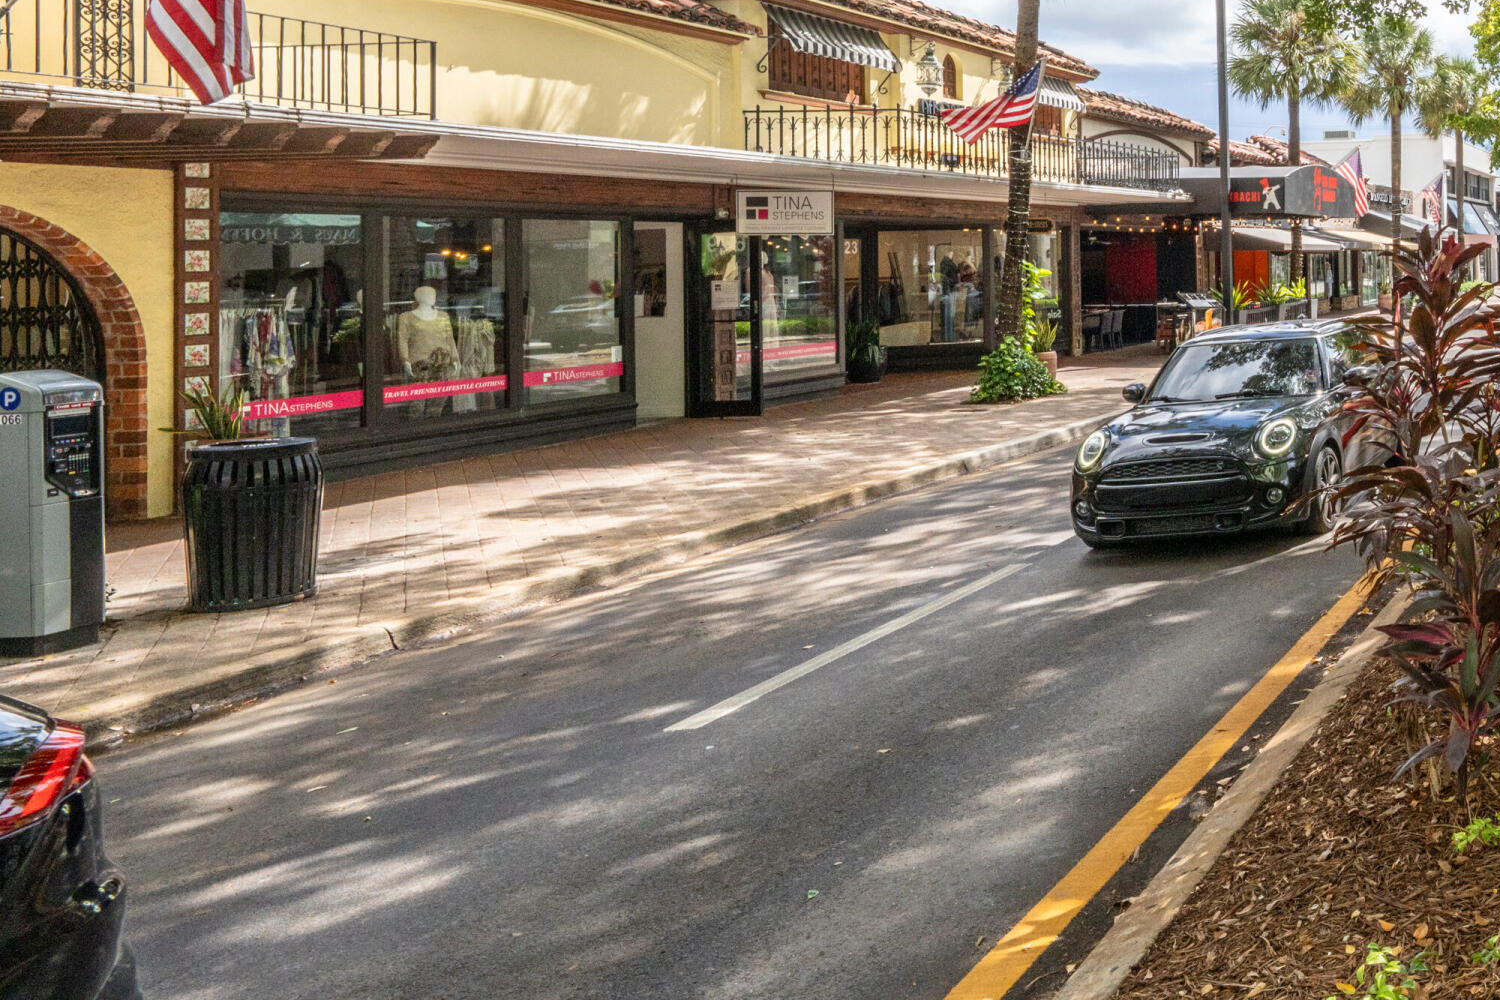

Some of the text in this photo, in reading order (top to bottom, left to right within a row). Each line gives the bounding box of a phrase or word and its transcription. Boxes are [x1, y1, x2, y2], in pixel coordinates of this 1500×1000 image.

[772, 195, 813, 210] TINA
[772, 210, 825, 221] STEPHENS
[552, 369, 604, 382] TINA STEPHENS
[383, 378, 505, 399] TRAVEL FRIENDLY LIFESTYLE CLOTHING
[4, 391, 17, 407] P
[254, 400, 334, 417] TINA STEPHENS
